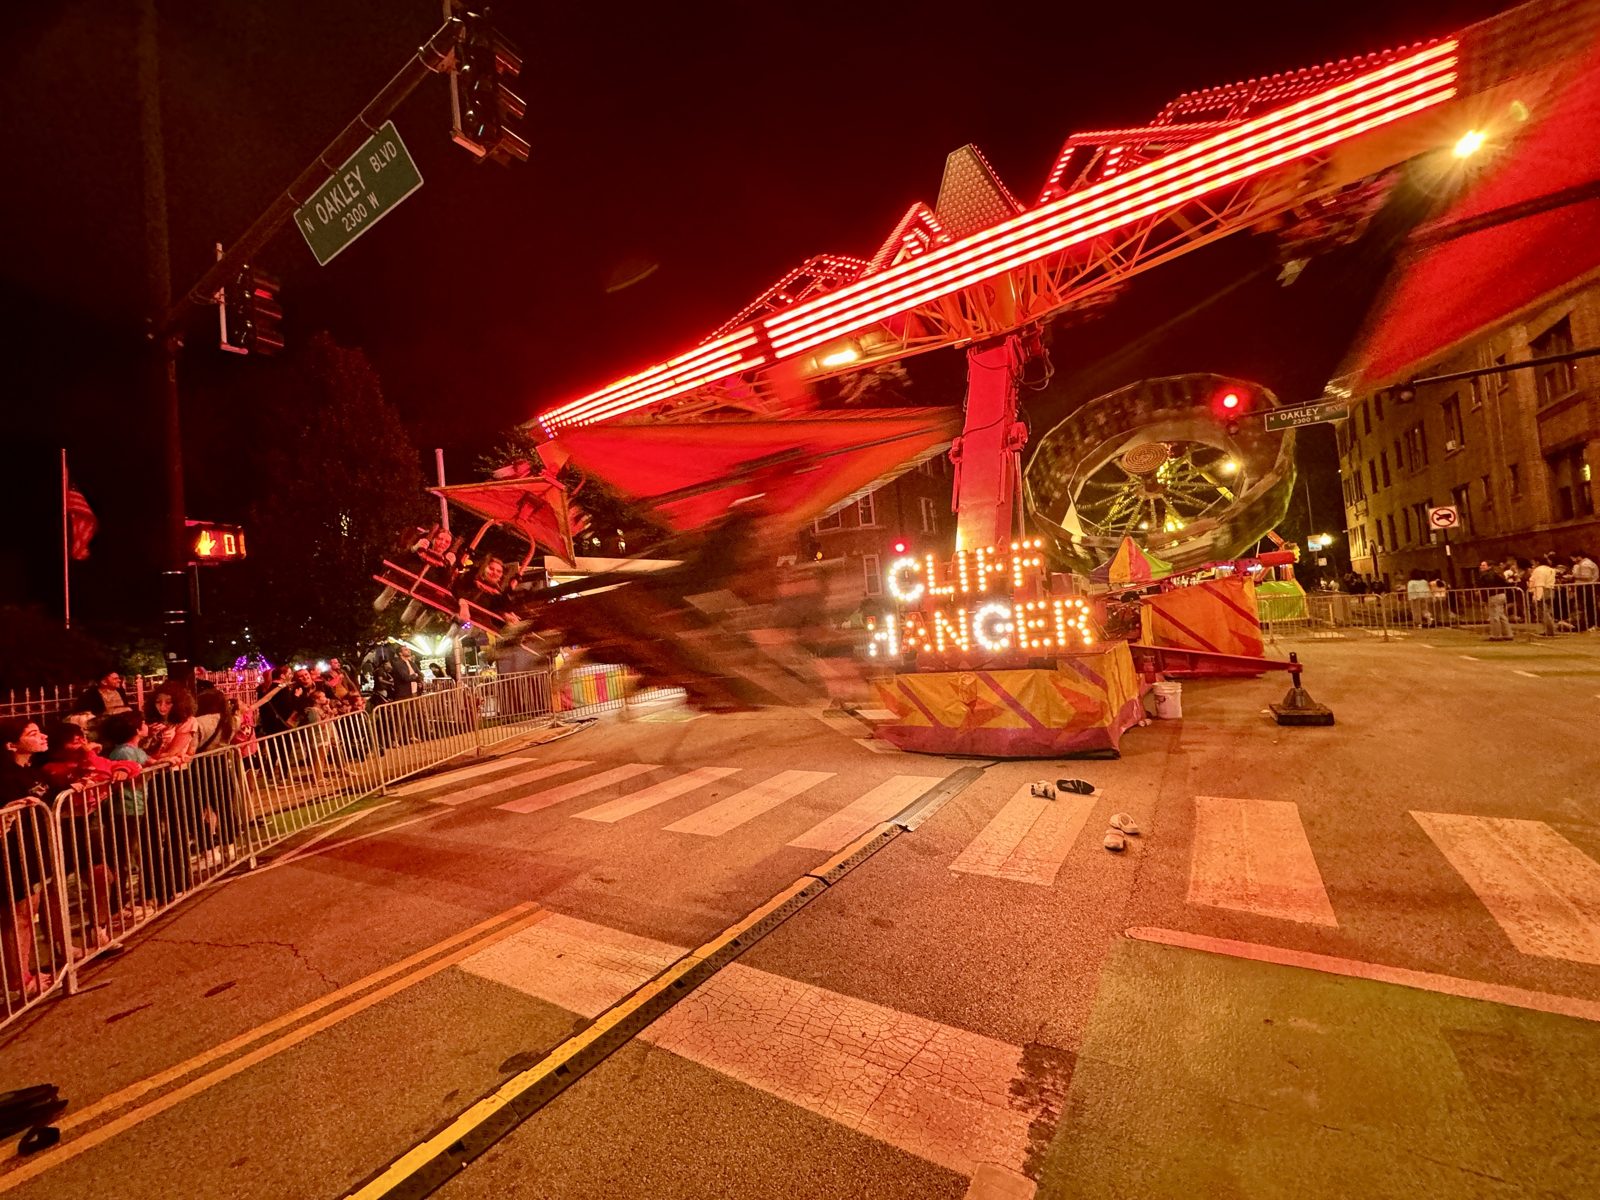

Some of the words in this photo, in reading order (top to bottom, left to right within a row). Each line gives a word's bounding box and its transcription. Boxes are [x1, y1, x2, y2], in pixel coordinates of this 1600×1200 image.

[303, 217, 315, 234] N
[315, 165, 366, 225] OAKLEY
[369, 140, 398, 173] BLVD
[341, 203, 368, 232] 2300
[366, 191, 380, 209] W
[1280, 407, 1319, 421] OAKLEY
[1292, 417, 1311, 425] 2300
[887, 538, 1043, 602] CLIFF
[866, 599, 1095, 657] HANGER
